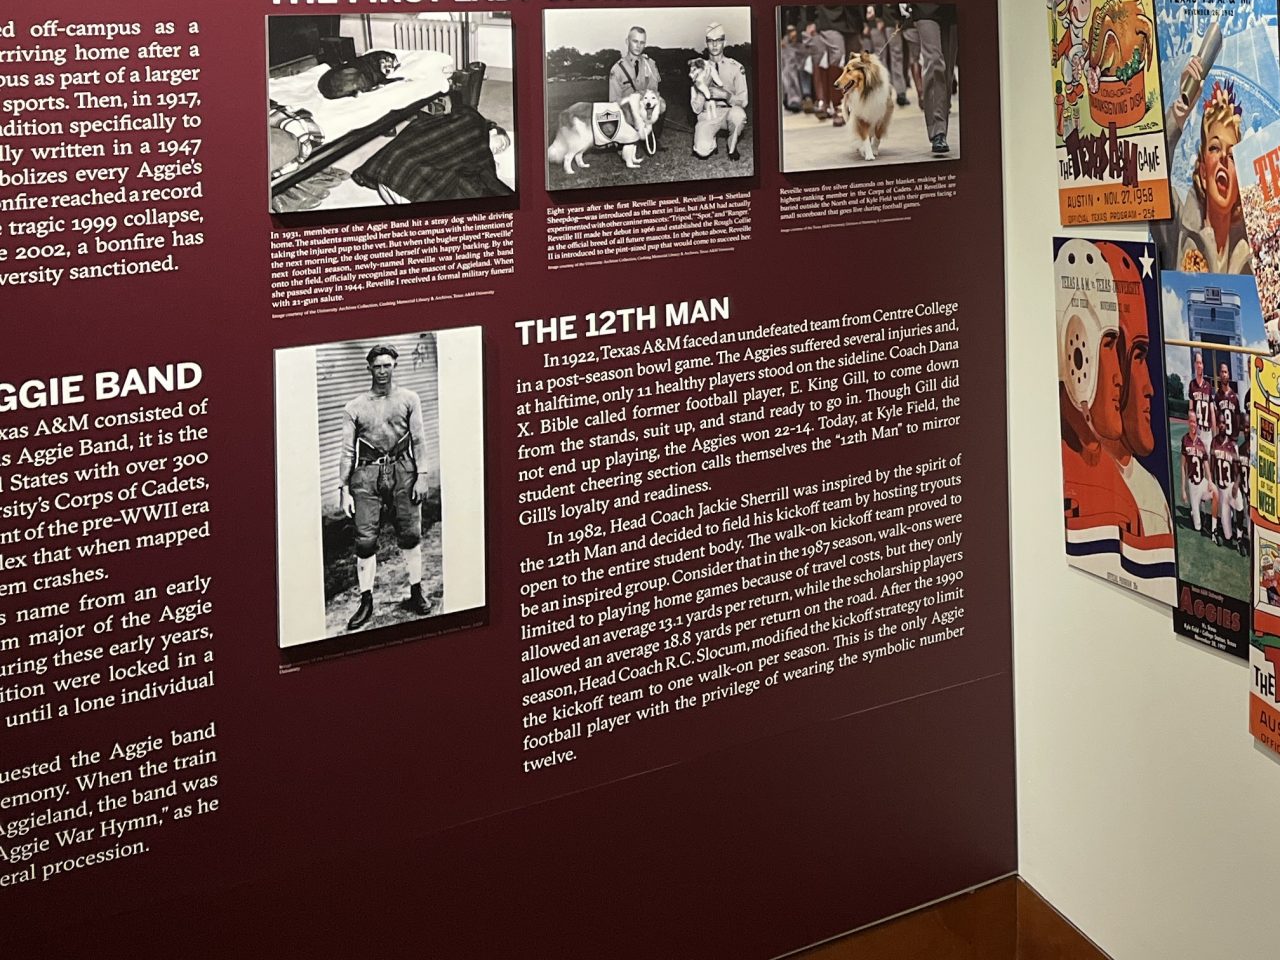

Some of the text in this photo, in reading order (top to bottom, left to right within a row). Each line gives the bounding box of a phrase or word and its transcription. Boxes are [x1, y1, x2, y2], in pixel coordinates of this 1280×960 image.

[75, 92, 201, 110] Then, 1917,
[1068, 188, 1154, 208] AUSTIN 1958
[515, 296, 730, 346] THE 12TH MAN
[562, 335, 682, 370] 1922, Texas A&M
[95, 362, 203, 401] BAND
[559, 480, 712, 519] loyalty readiness.
[523, 749, 577, 773] twelve.
[42, 840, 150, 882] procession.
